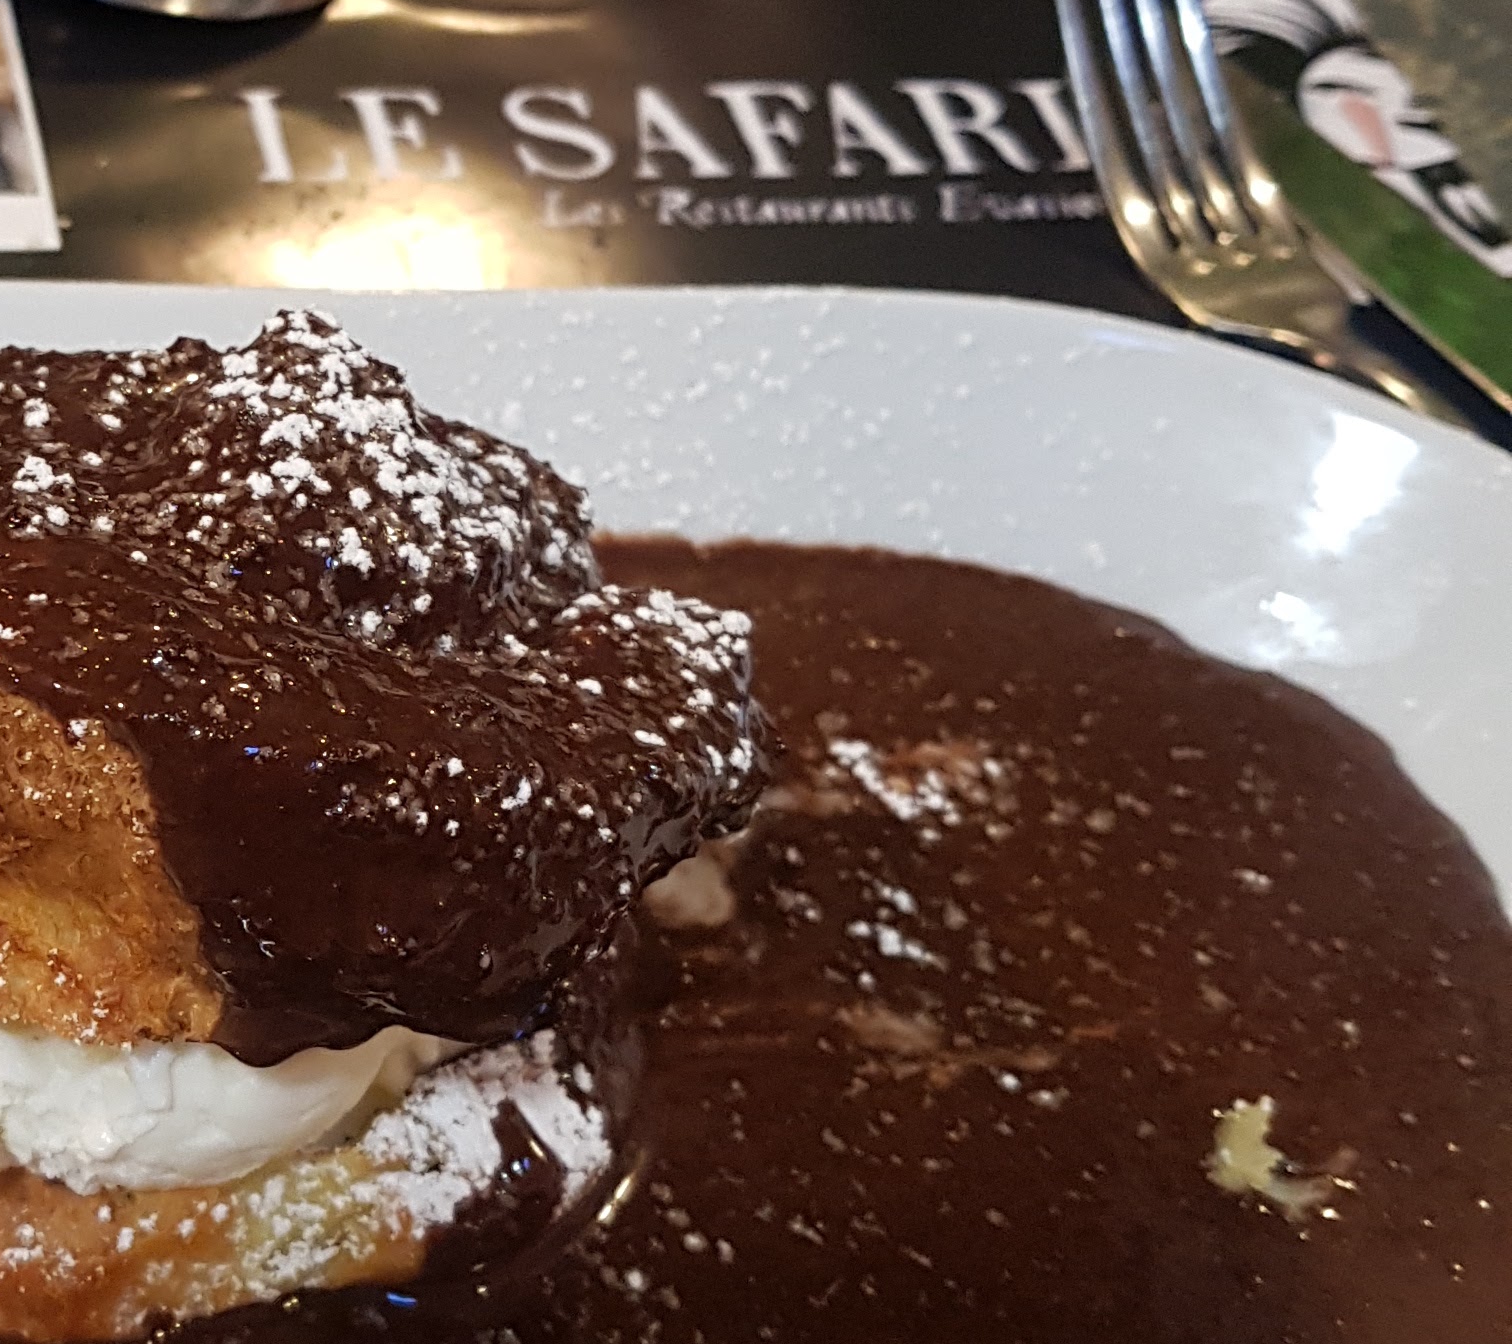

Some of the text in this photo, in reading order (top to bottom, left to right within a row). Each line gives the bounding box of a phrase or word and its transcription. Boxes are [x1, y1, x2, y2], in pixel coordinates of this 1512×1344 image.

[236, 77, 1092, 183] LE SAFARI
[636, 184, 917, 229] Restaurants
